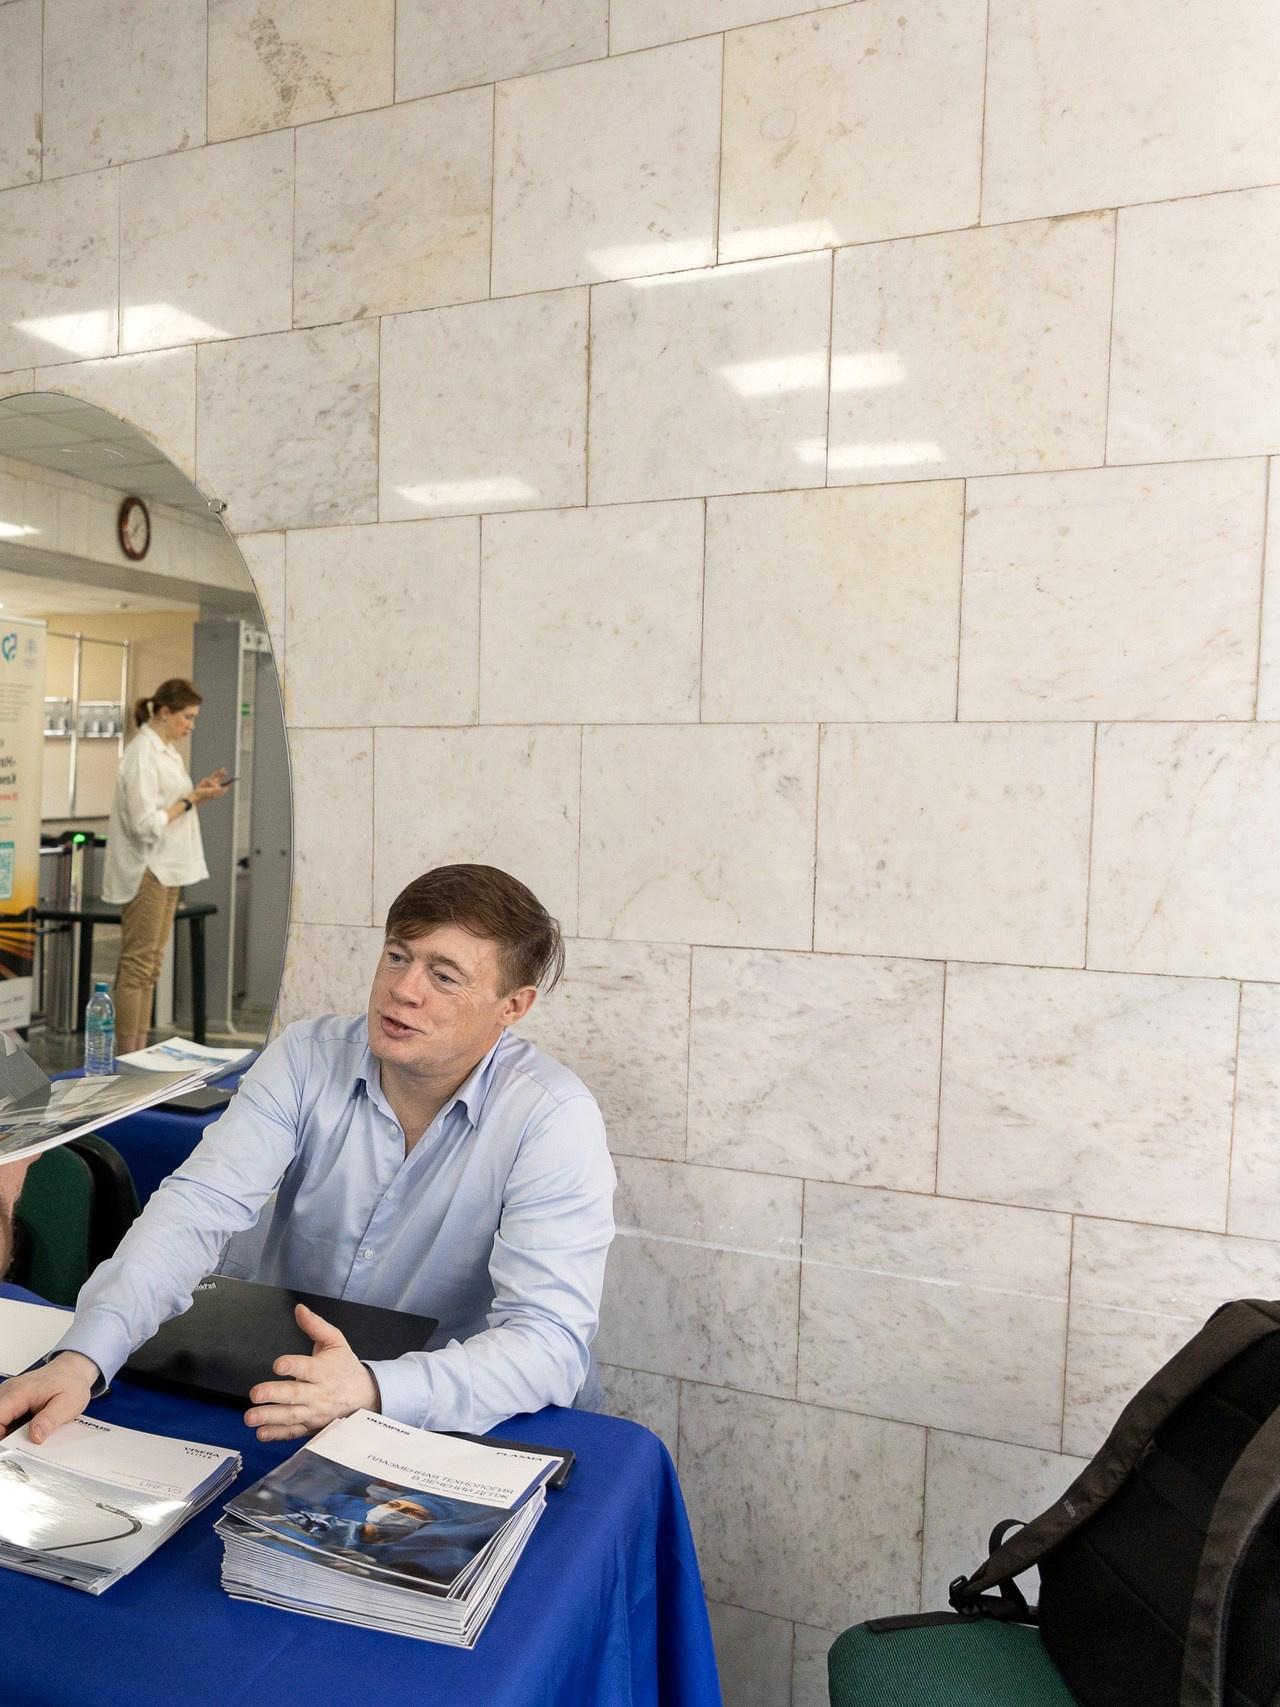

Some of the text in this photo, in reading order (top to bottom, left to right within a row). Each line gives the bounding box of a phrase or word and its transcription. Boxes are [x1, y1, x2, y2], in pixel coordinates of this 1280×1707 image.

[74, 1418, 112, 1432] YMPUS
[366, 1417, 411, 1436] OLYMPUS
[184, 1446, 220, 1458] VISERA
[496, 1451, 543, 1462] PLASMA
[366, 1454, 440, 1479] ПЛАЗМЕННАЯ
[442, 1476, 515, 1494] ТЕХНОЛОГИЯ
[422, 1478, 473, 1493] ЛЕЧЕНИИ
